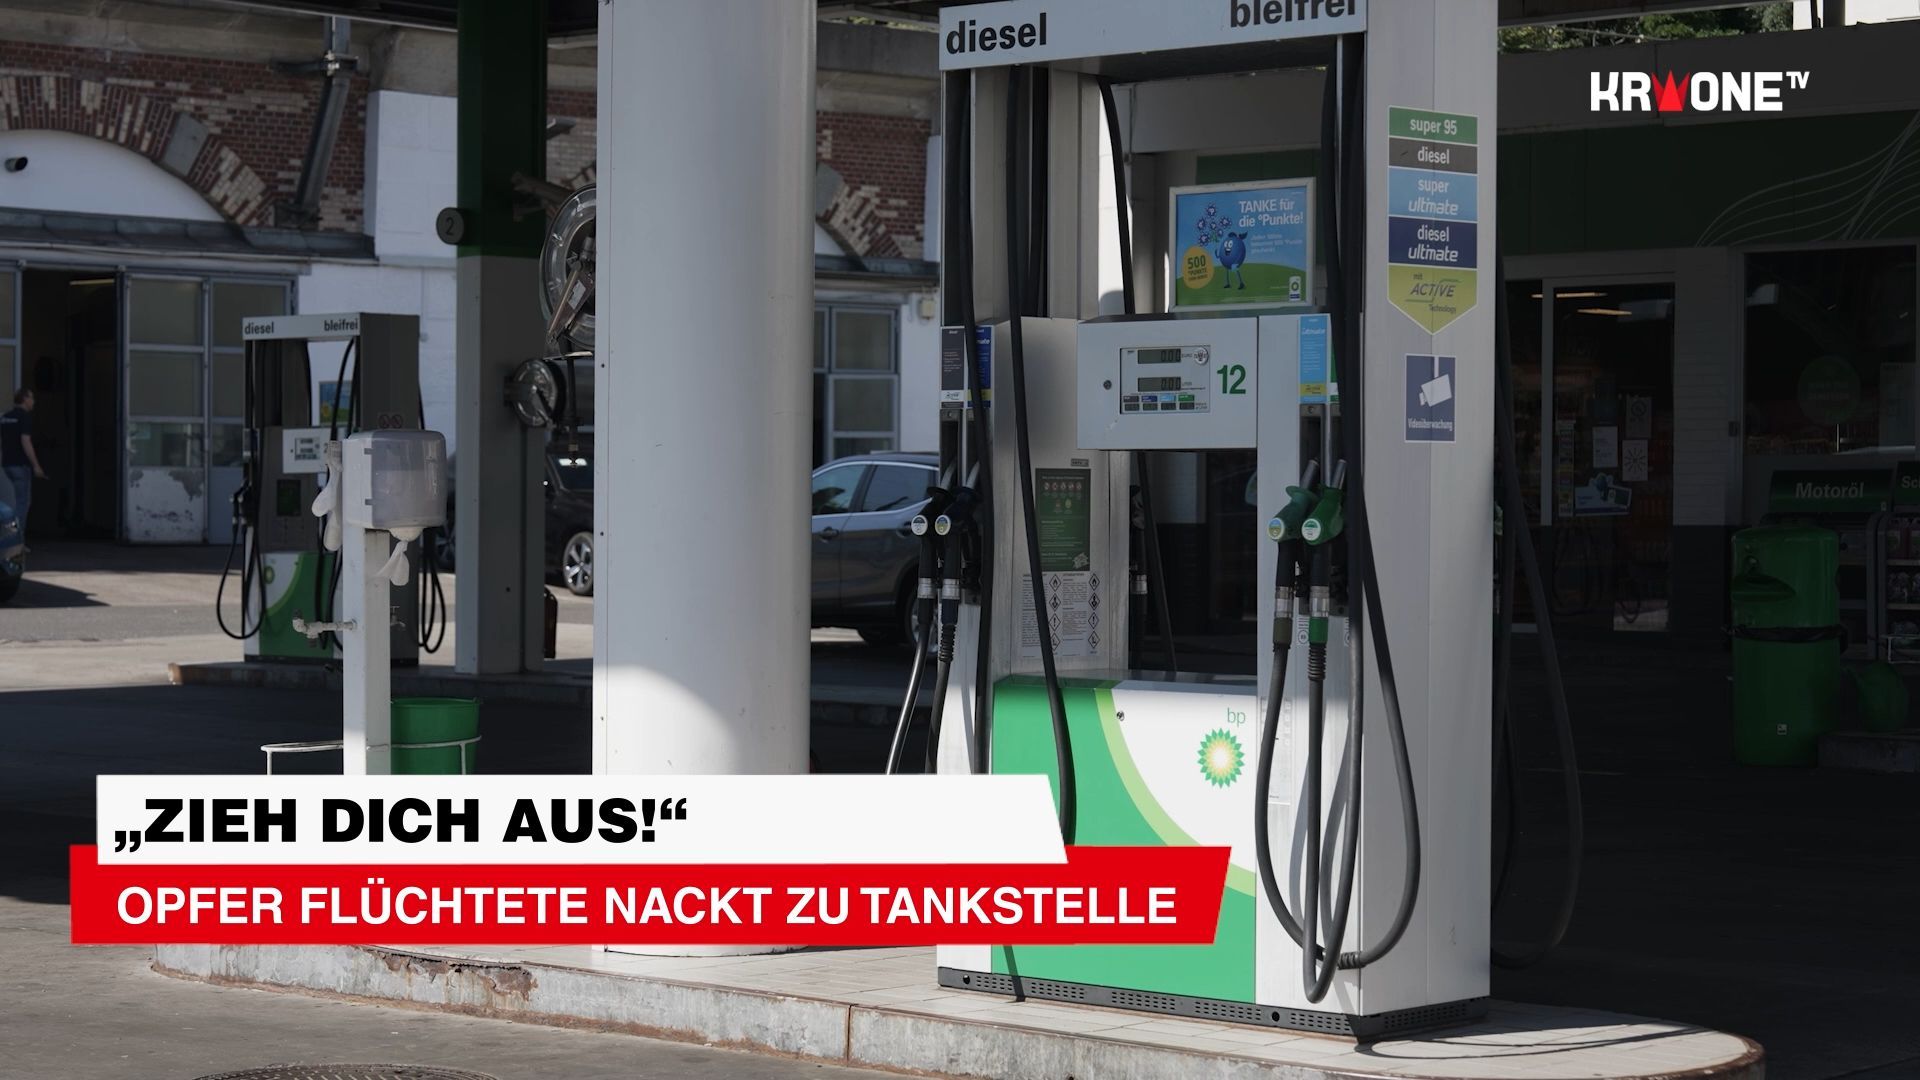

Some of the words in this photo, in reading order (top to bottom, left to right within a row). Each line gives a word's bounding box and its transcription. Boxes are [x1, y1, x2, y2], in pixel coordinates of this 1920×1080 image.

[946, 13, 1047, 54] diesel
[1409, 119, 1441, 135] super
[1443, 119, 1457, 135] 95
[1417, 146, 1450, 164] diesel
[1418, 179, 1450, 195] super
[1239, 200, 1278, 213] TANKE
[1279, 198, 1295, 211] für
[1408, 197, 1459, 216] ultimate
[445, 216, 455, 236] 2
[1239, 217, 1256, 228] die
[1417, 224, 1450, 242] diesel
[1408, 243, 1459, 262] ultimate
[1187, 254, 1207, 270] 500
[1410, 283, 1456, 298] ACTIVE
[244, 321, 275, 335] diesel
[323, 318, 358, 332] bleifrei
[1216, 364, 1247, 395] 12
[1795, 482, 1865, 498] Motoröl
[1901, 475, 1920, 489] Sc
[1227, 707, 1246, 728] bp
